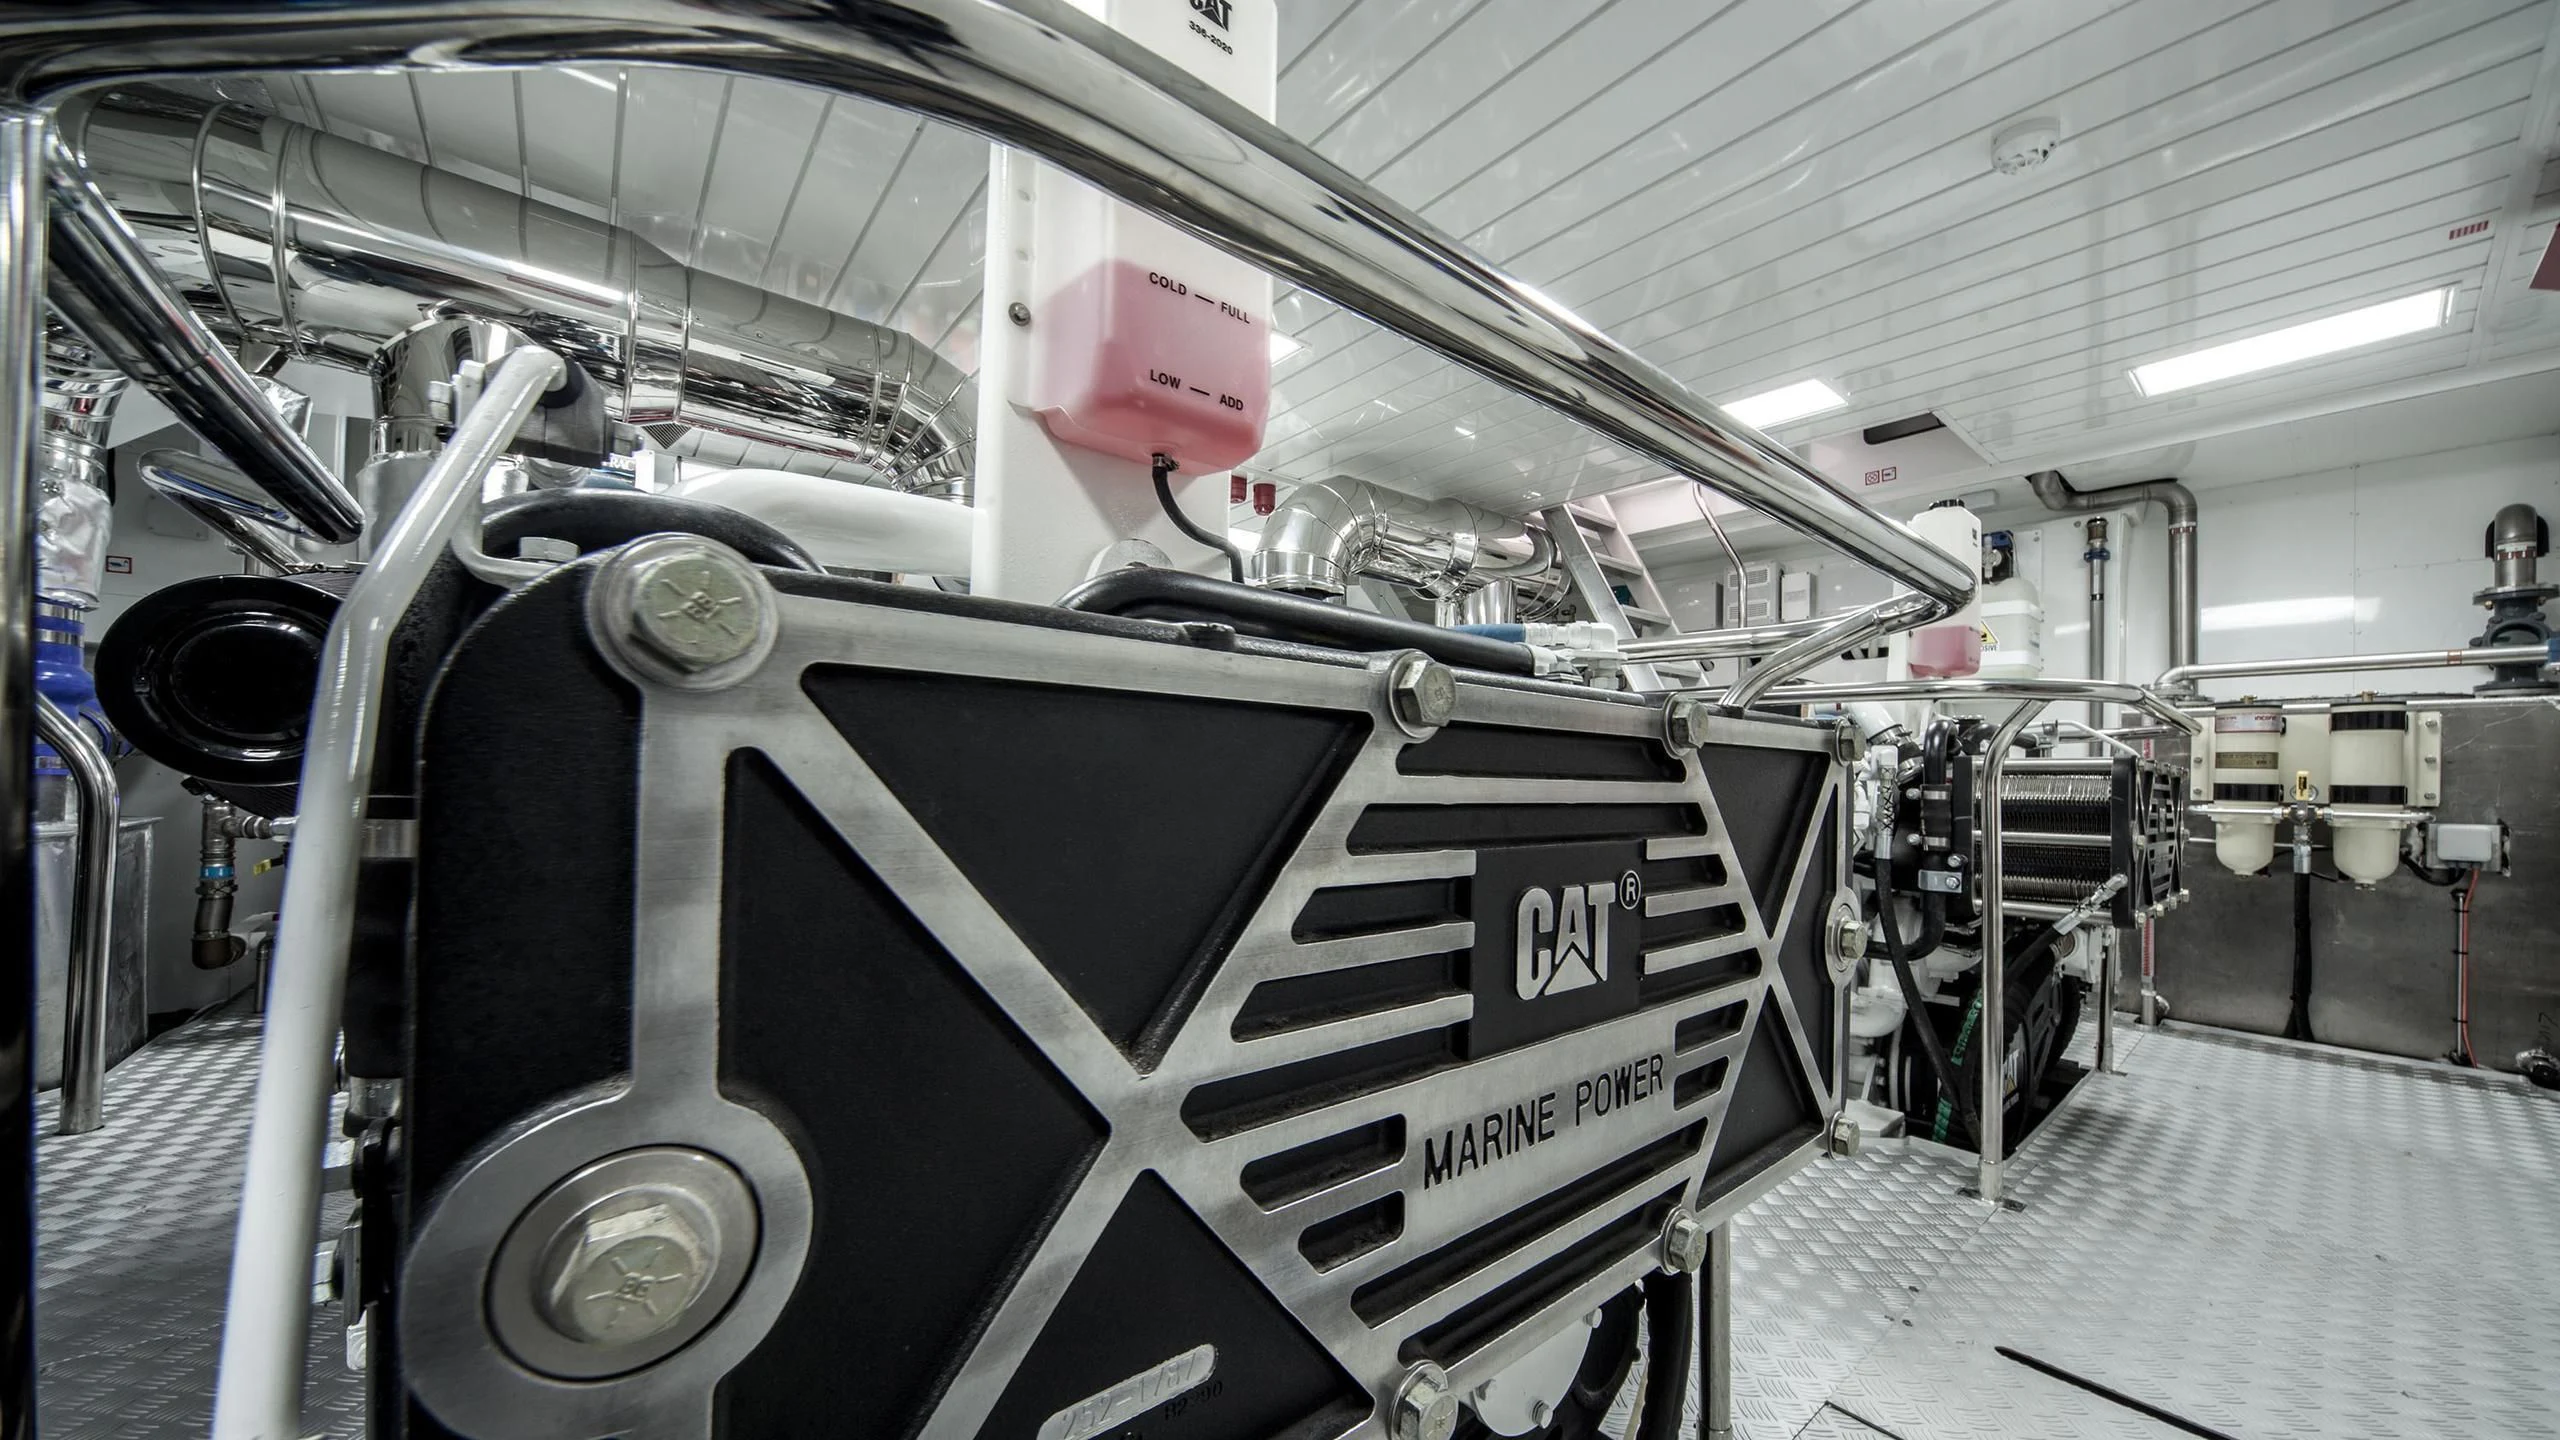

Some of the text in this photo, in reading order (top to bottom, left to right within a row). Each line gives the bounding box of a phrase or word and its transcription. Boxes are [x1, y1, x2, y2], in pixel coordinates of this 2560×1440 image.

[1189, 20, 1233, 55] 336-2020
[1149, 272, 1250, 324] COLD FULL
[1150, 369, 1244, 411] LOW ADD
[1516, 882, 1616, 1000] CAT
[1423, 1053, 1664, 1191] MARINE POWER
